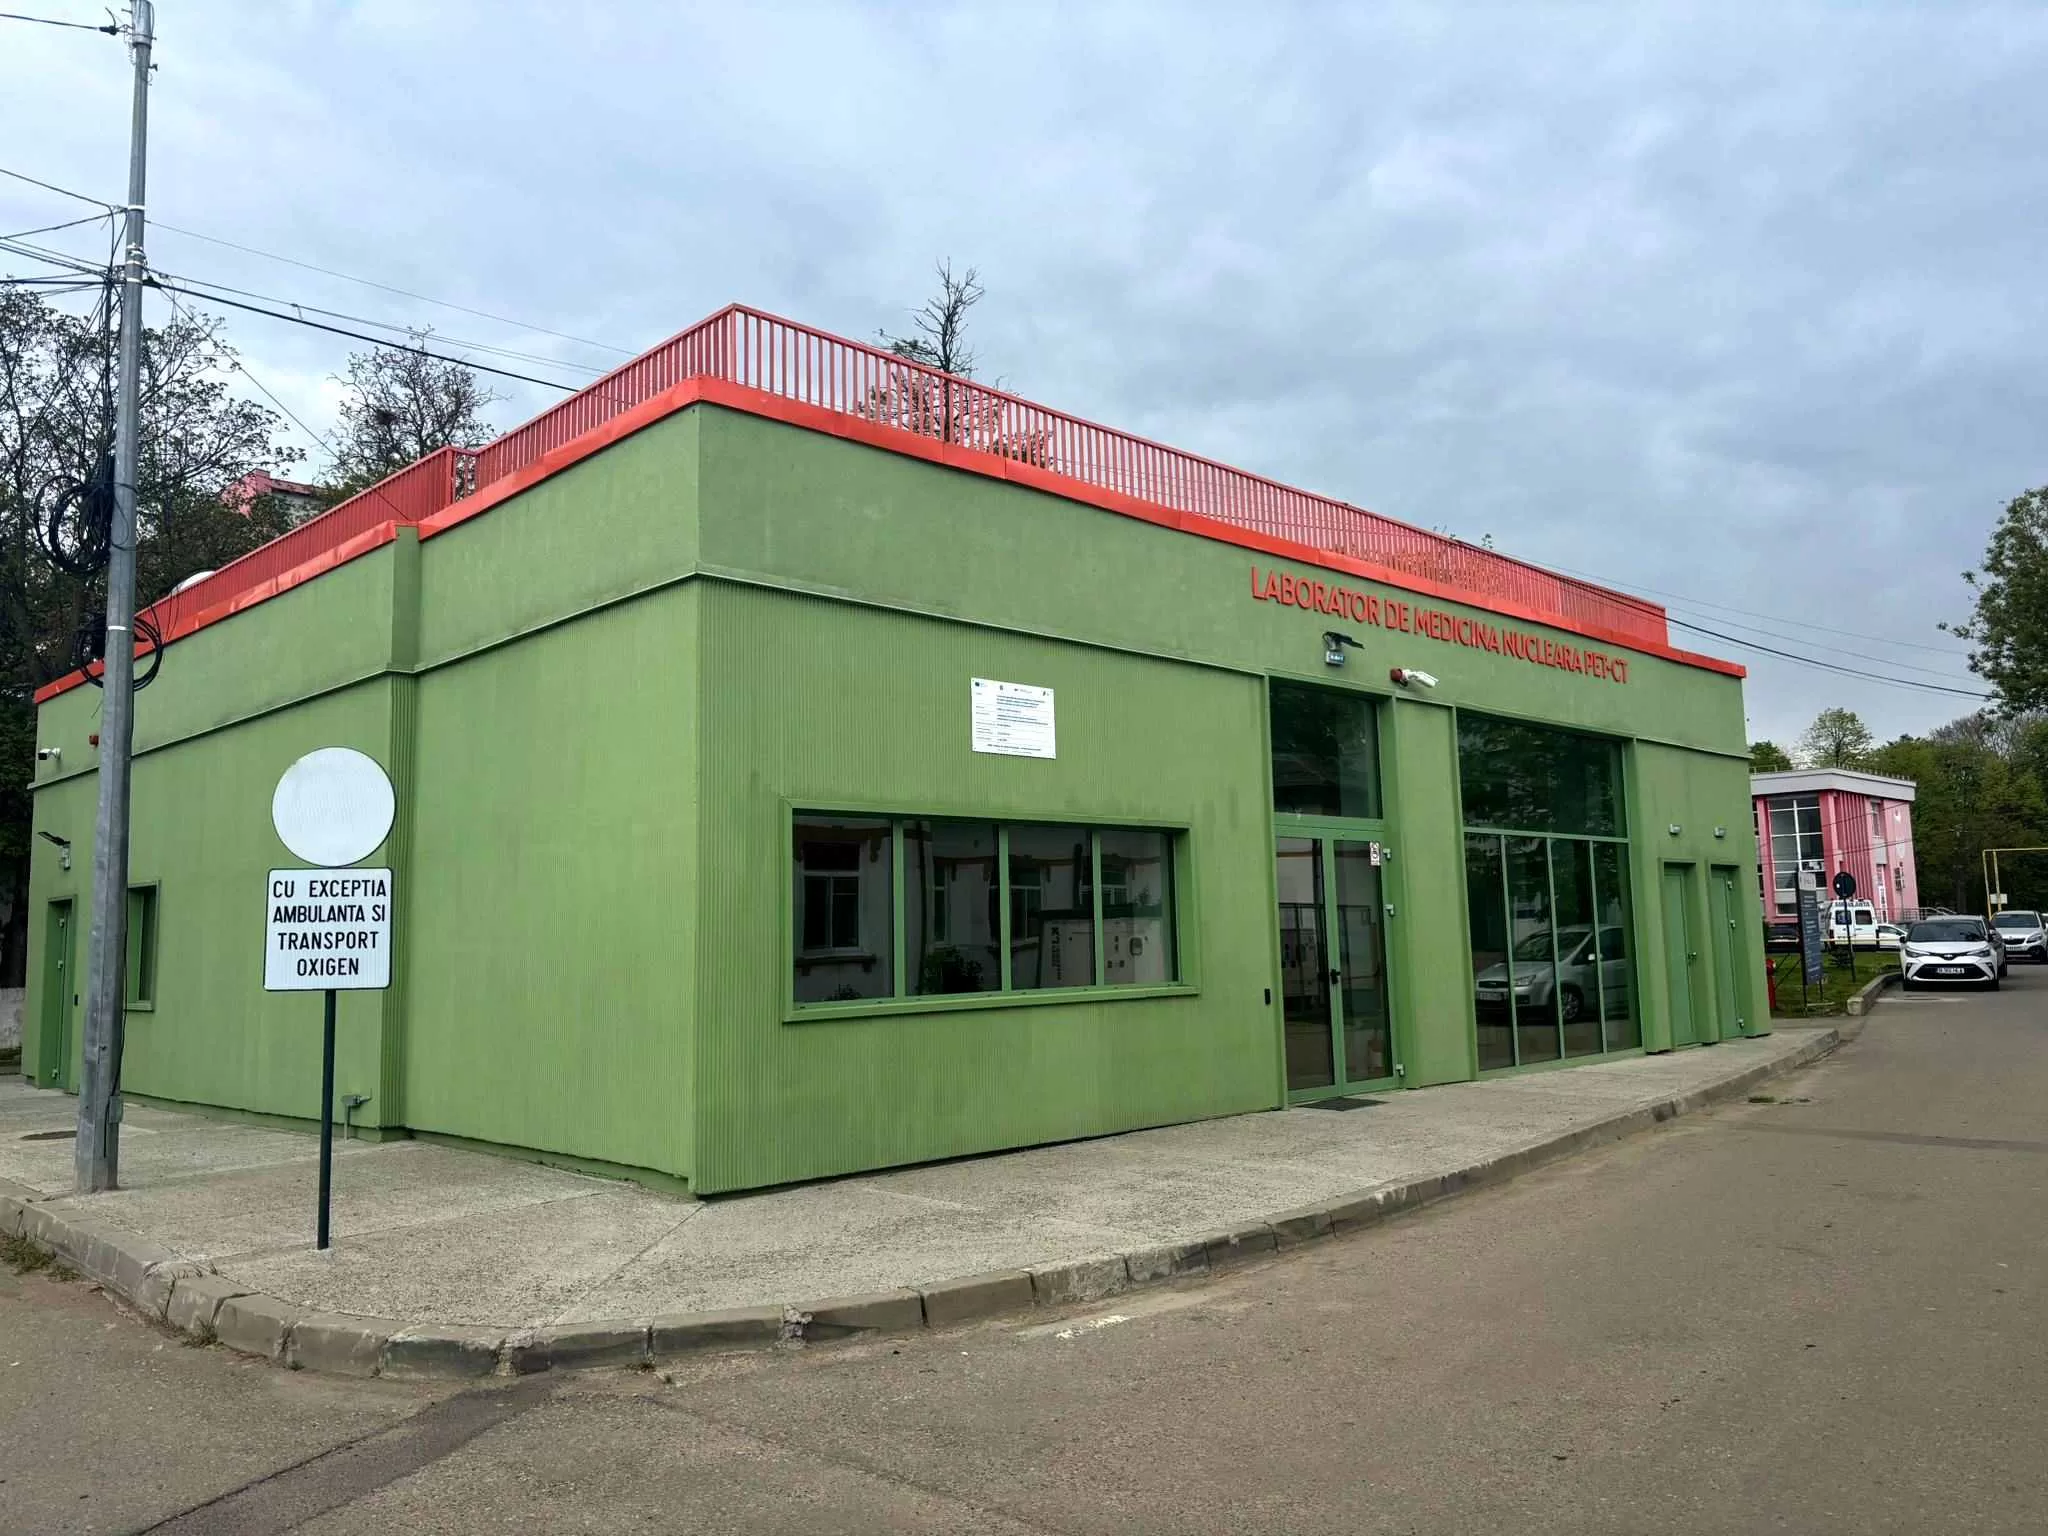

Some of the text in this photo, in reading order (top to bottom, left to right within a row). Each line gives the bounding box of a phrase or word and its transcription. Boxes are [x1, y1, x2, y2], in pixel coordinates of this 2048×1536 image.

[1252, 567, 1629, 684] LABORATOR DE MEDICINA NUCLEARA PET-CT
[272, 879, 387, 898] CU EXCEPTIA
[272, 904, 386, 924] AMBULANTA SI
[278, 931, 380, 950] TRANSPORT
[296, 957, 360, 977] OXIGEN
